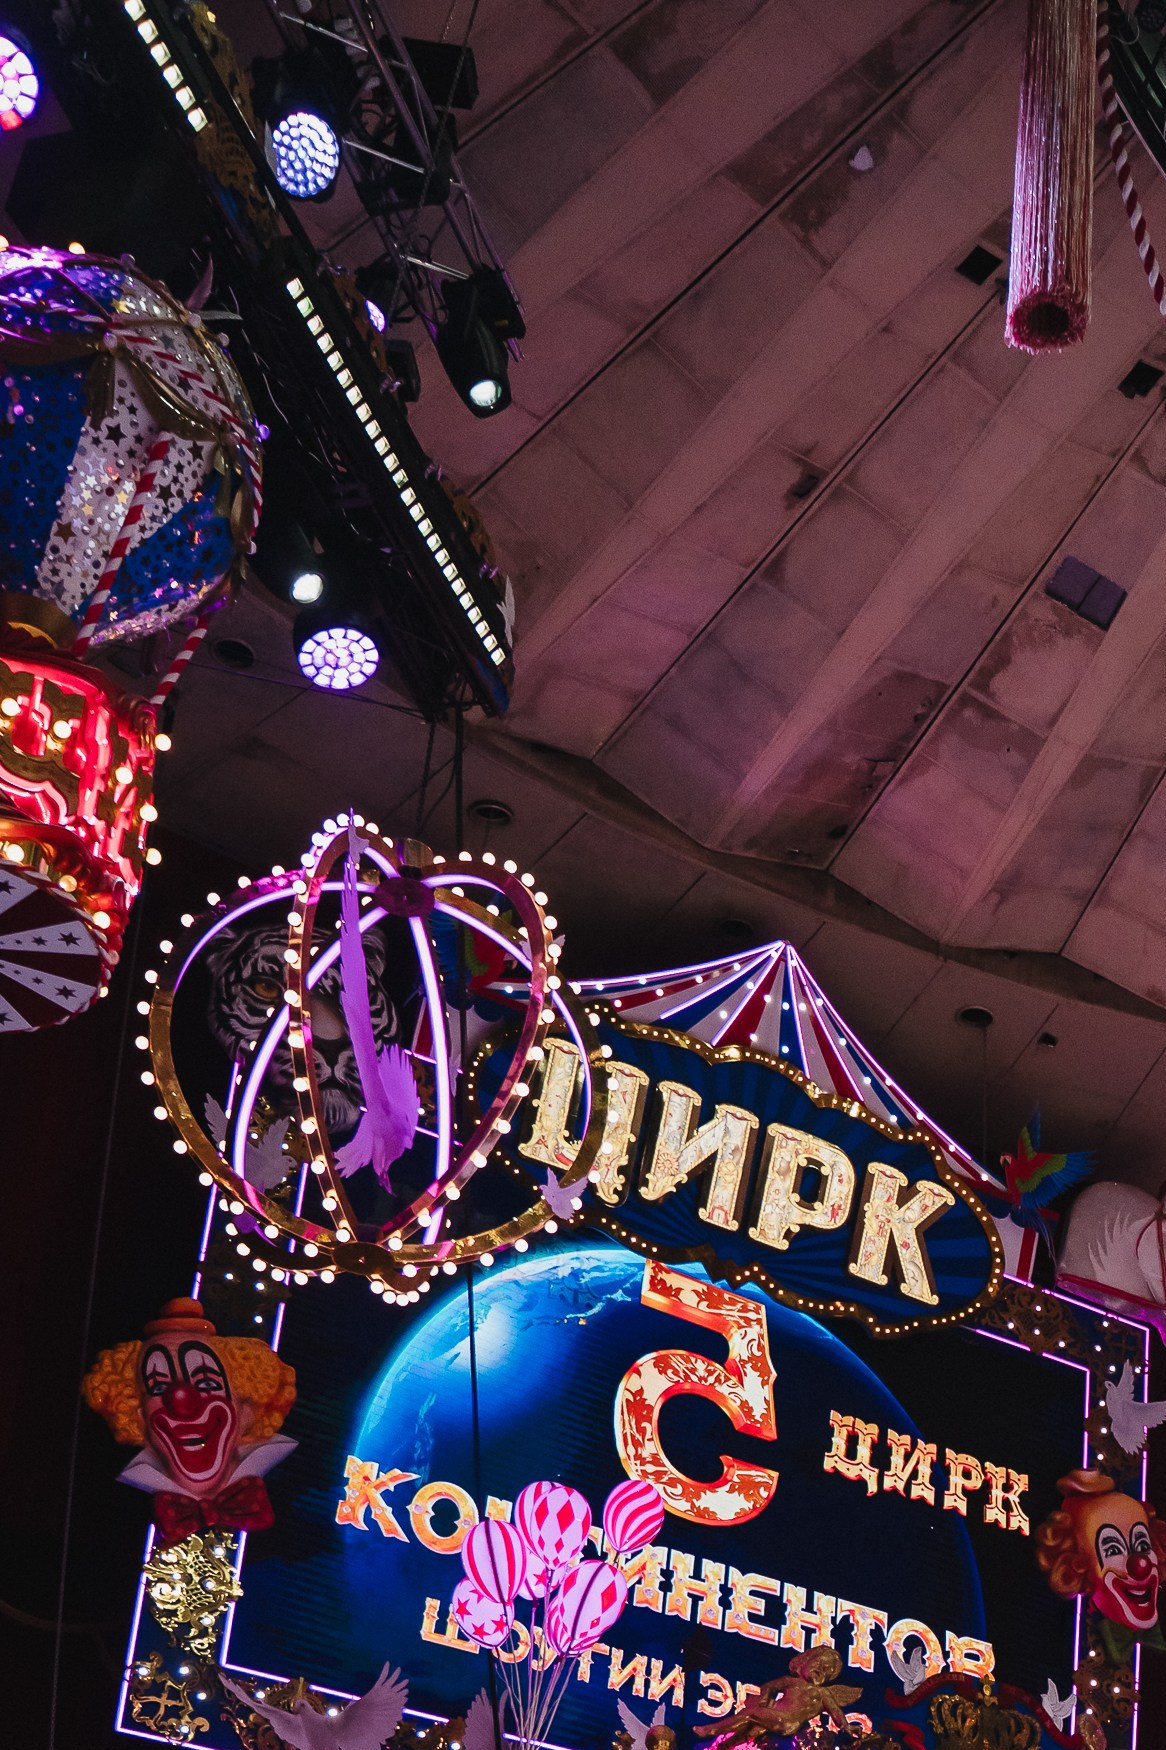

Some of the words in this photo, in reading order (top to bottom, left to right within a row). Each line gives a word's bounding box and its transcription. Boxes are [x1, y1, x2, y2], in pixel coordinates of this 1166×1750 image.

[517, 1037, 956, 1306] ЦИРК
[614, 1259, 780, 1525] 5
[822, 1411, 1031, 1536] ЦИРК
[336, 1455, 995, 1681] КОИНЕНТОВ
